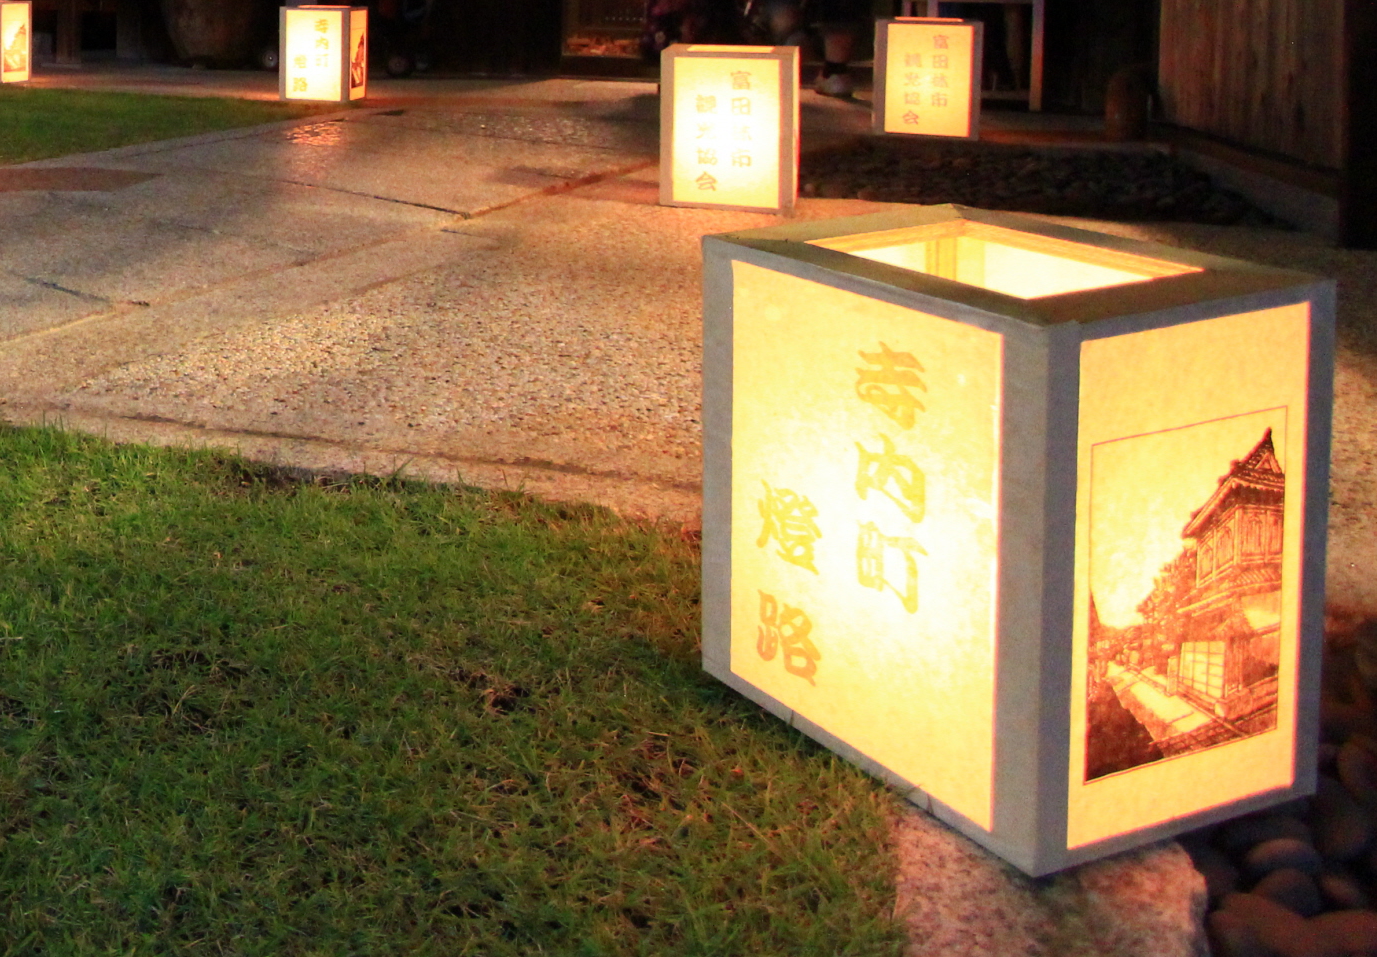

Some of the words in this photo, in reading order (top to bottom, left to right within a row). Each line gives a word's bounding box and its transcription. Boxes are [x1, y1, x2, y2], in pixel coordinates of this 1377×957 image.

[756, 479, 822, 687] 燈路
[855, 341, 928, 614] 寺内町
